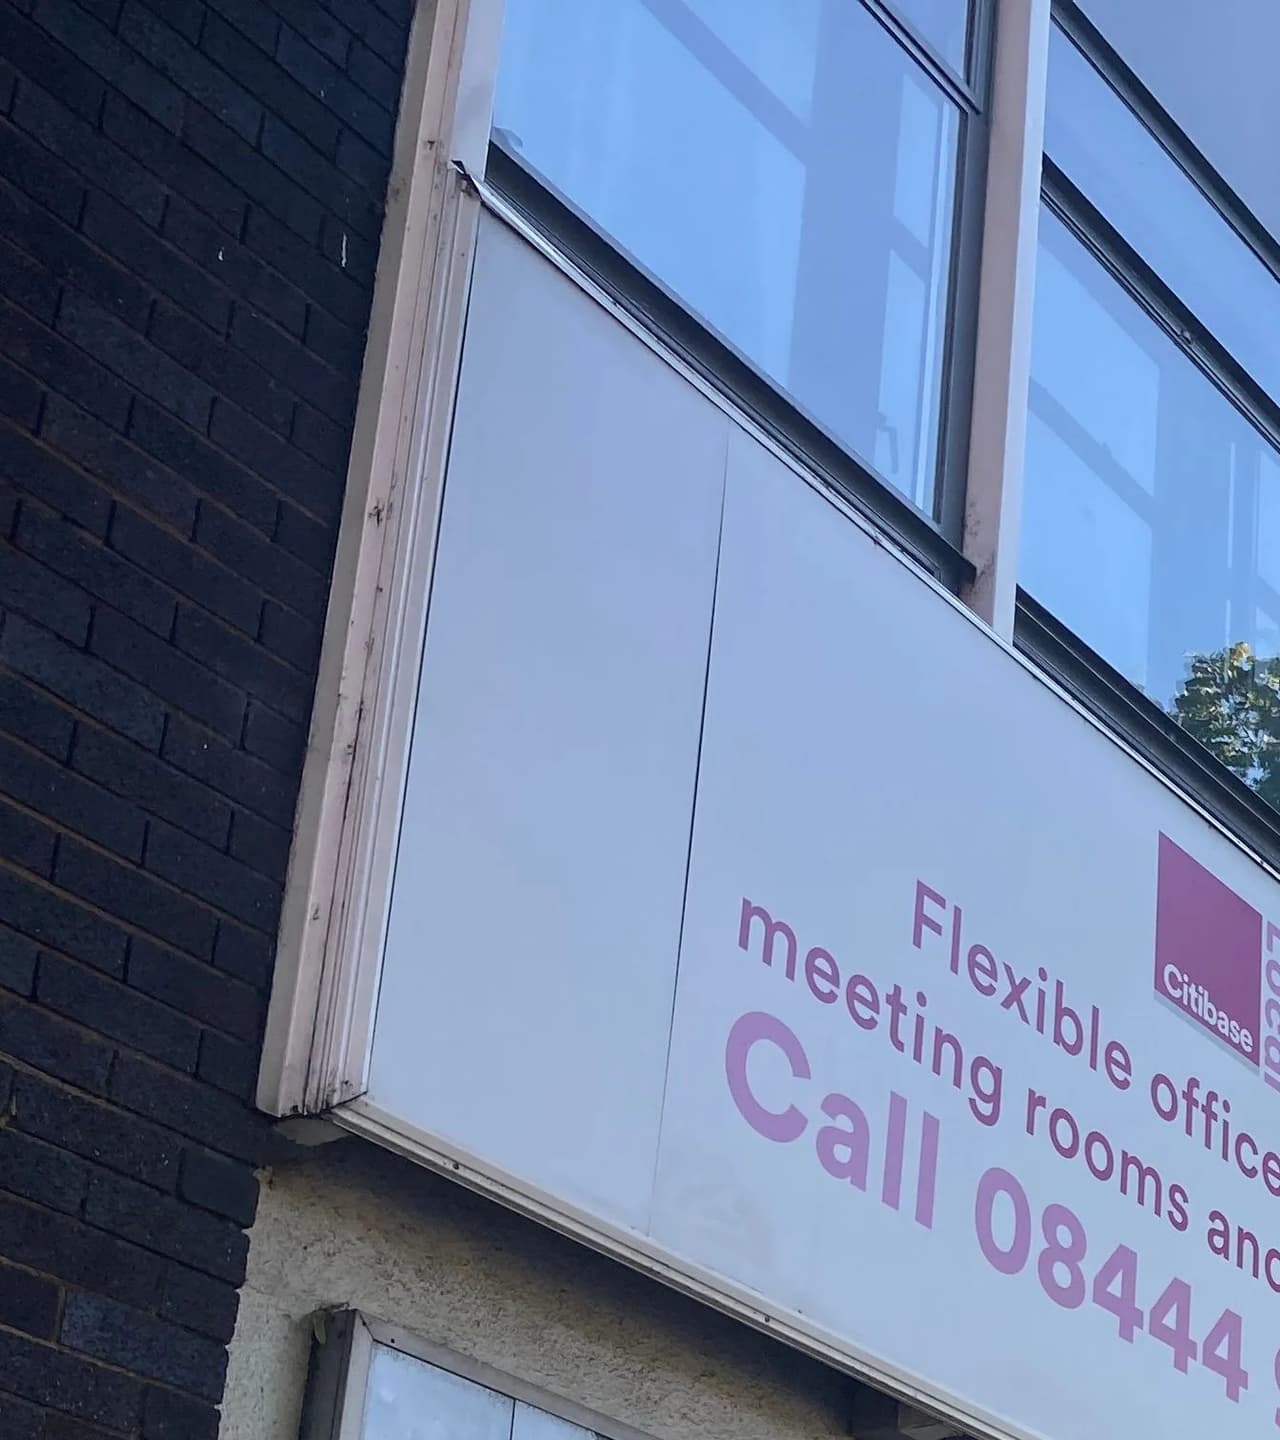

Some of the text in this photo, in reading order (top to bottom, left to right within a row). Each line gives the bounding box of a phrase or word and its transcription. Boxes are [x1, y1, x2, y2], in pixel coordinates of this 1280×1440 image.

[737, 897, 1003, 1127] meeting
[1026, 1087, 1189, 1232] rooms
[912, 879, 1133, 1091] Flexible
[1163, 963, 1254, 1053] Citibase
[724, 1010, 941, 1231] Call
[974, 1166, 1249, 1404] 08444
